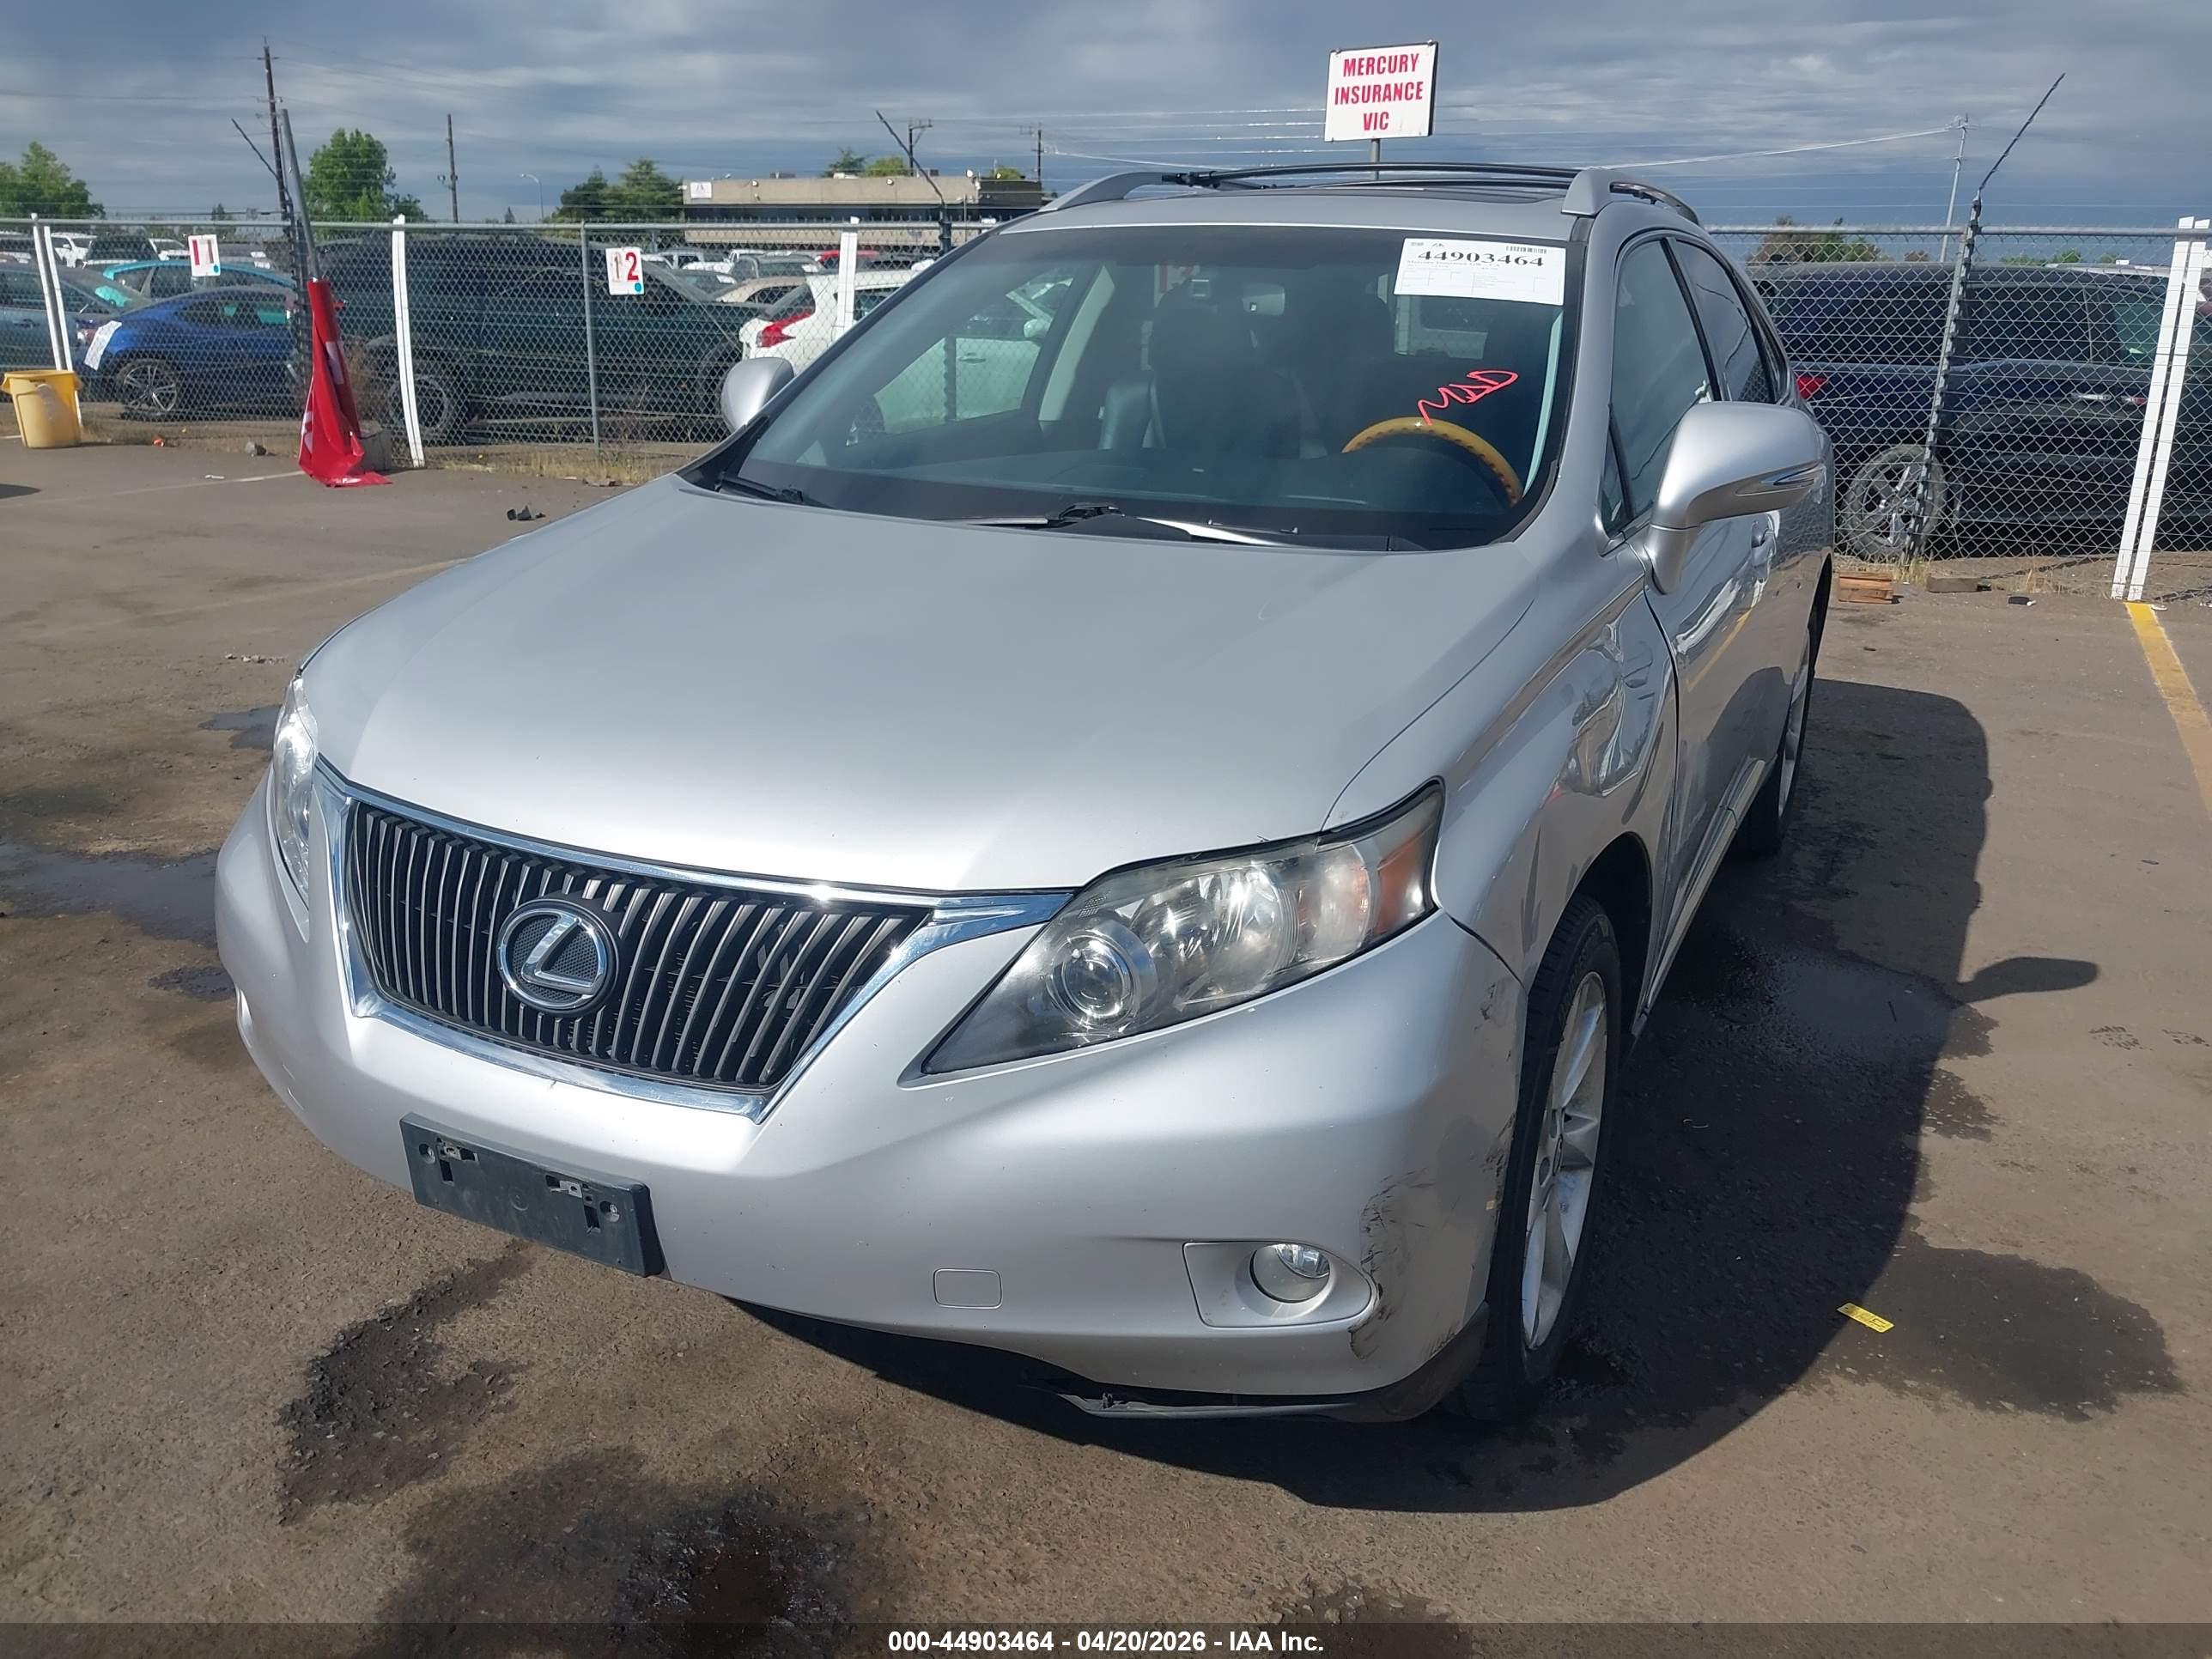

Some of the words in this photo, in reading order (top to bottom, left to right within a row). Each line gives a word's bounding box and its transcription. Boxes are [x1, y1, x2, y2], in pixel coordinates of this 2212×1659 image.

[1343, 53, 1419, 77] MERCURY
[1334, 82, 1424, 106] INSURANCE
[1364, 112, 1389, 131] VIC
[613, 252, 639, 281] 12
[1418, 250, 1545, 267] 44903464
